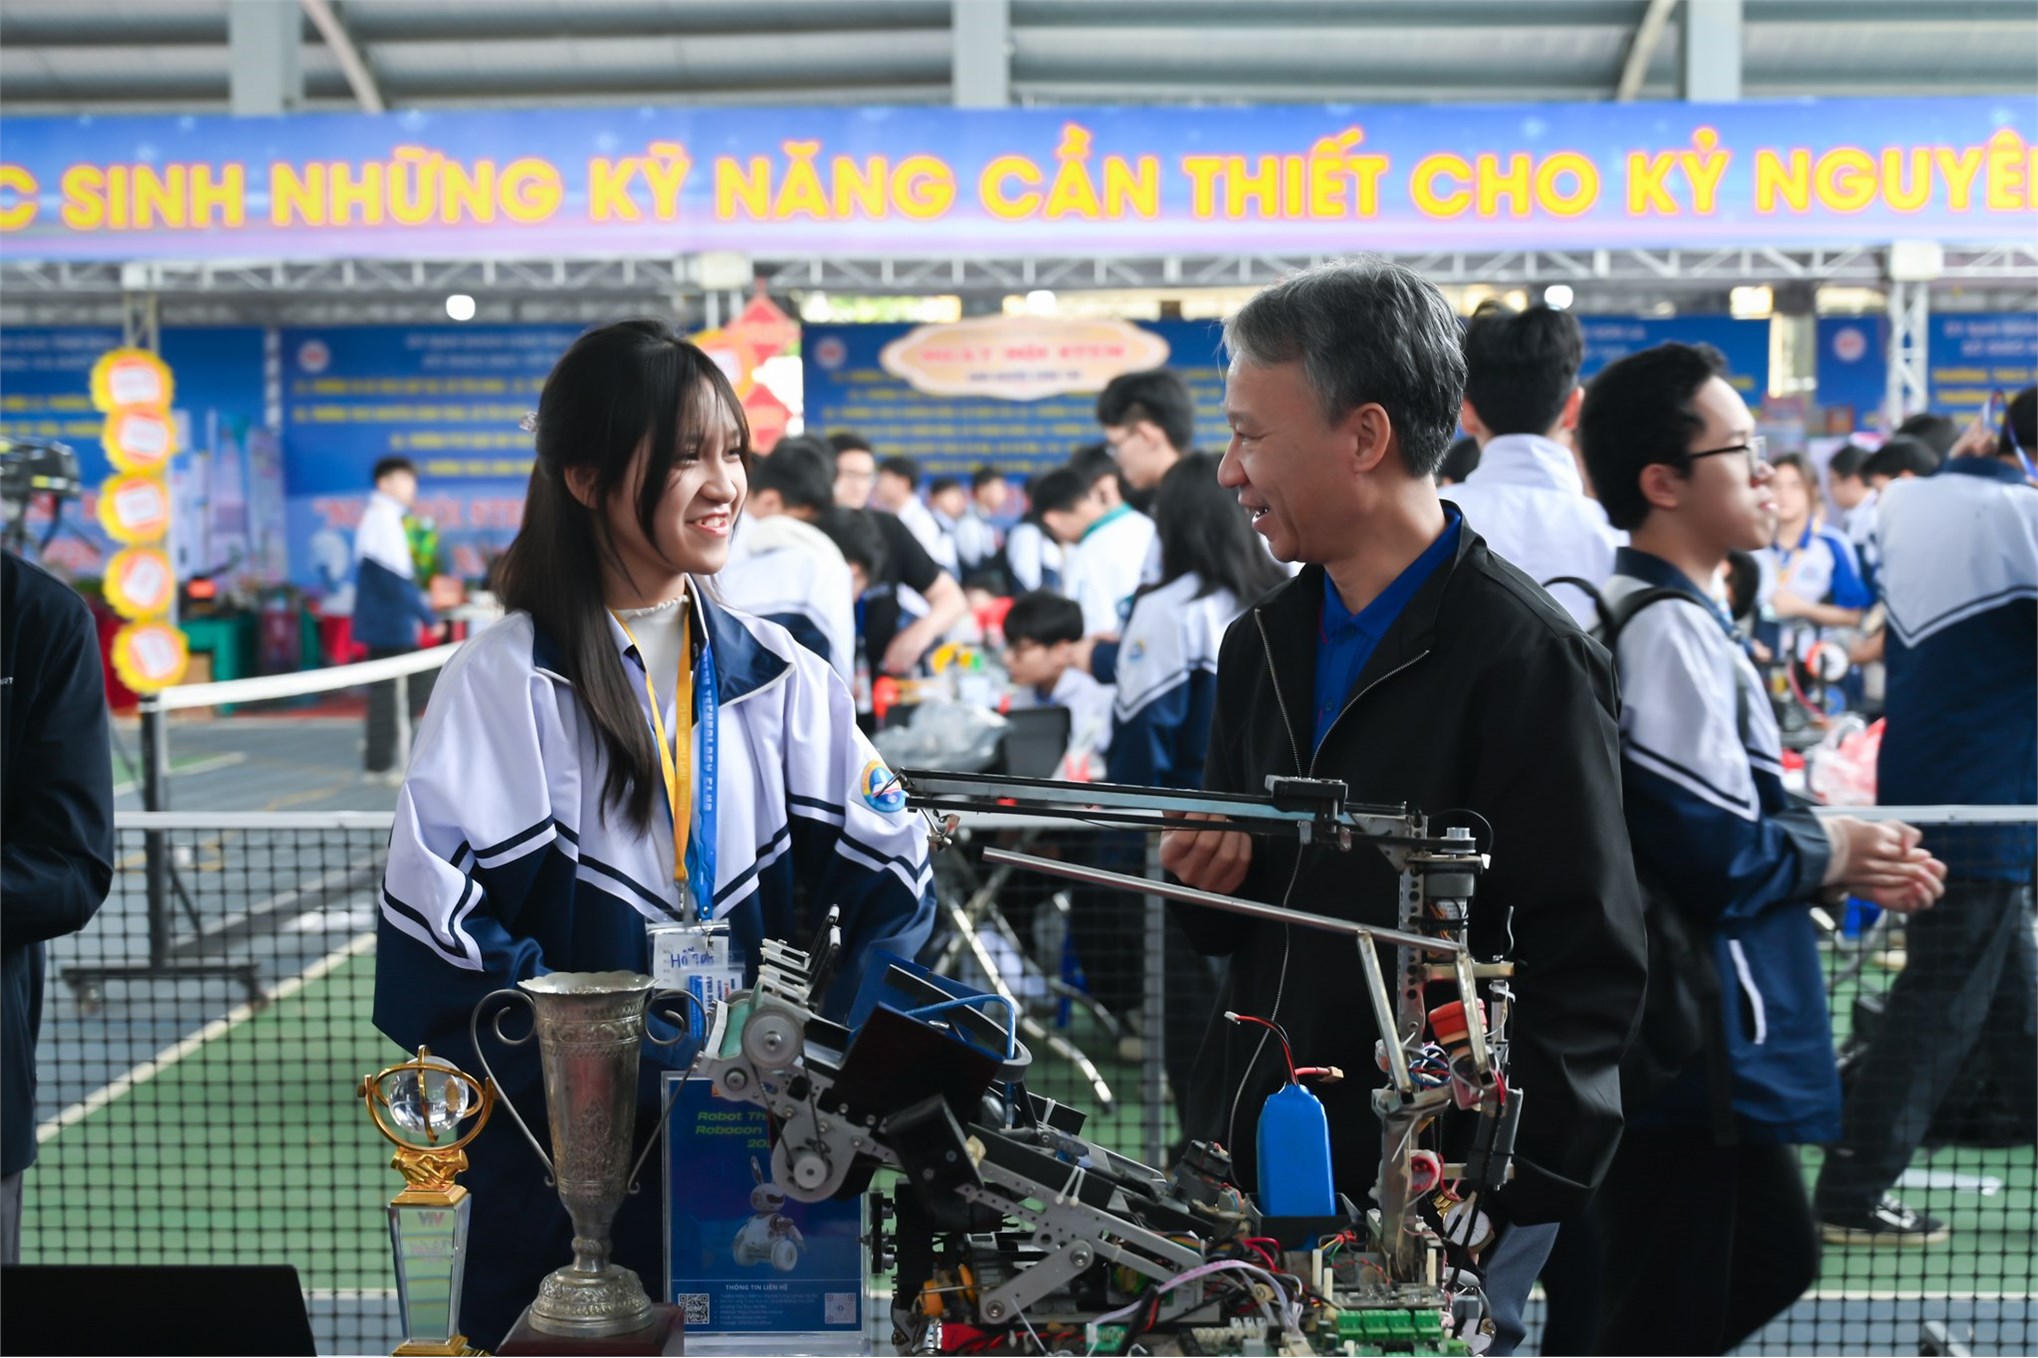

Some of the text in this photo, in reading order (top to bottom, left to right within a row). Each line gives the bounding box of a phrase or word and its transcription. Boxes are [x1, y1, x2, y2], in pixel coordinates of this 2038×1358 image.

[60, 163, 244, 230] SINH
[270, 144, 563, 227] NHỮNG
[589, 139, 691, 224] KỸ
[715, 140, 956, 221] NĂNG
[979, 121, 1159, 220] CẦN
[1182, 126, 1389, 220] THIẾT
[1411, 151, 1599, 218] CHO
[1626, 126, 1730, 217] KỶ
[1755, 127, 2038, 214] NGUYÊ
[697, 1111, 768, 1121] Robot Th
[695, 1125, 762, 1135] Robocon
[747, 1138, 770, 1148] 20
[725, 1283, 749, 1291] THÔNG
[763, 1283, 778, 1291] LIÊN
